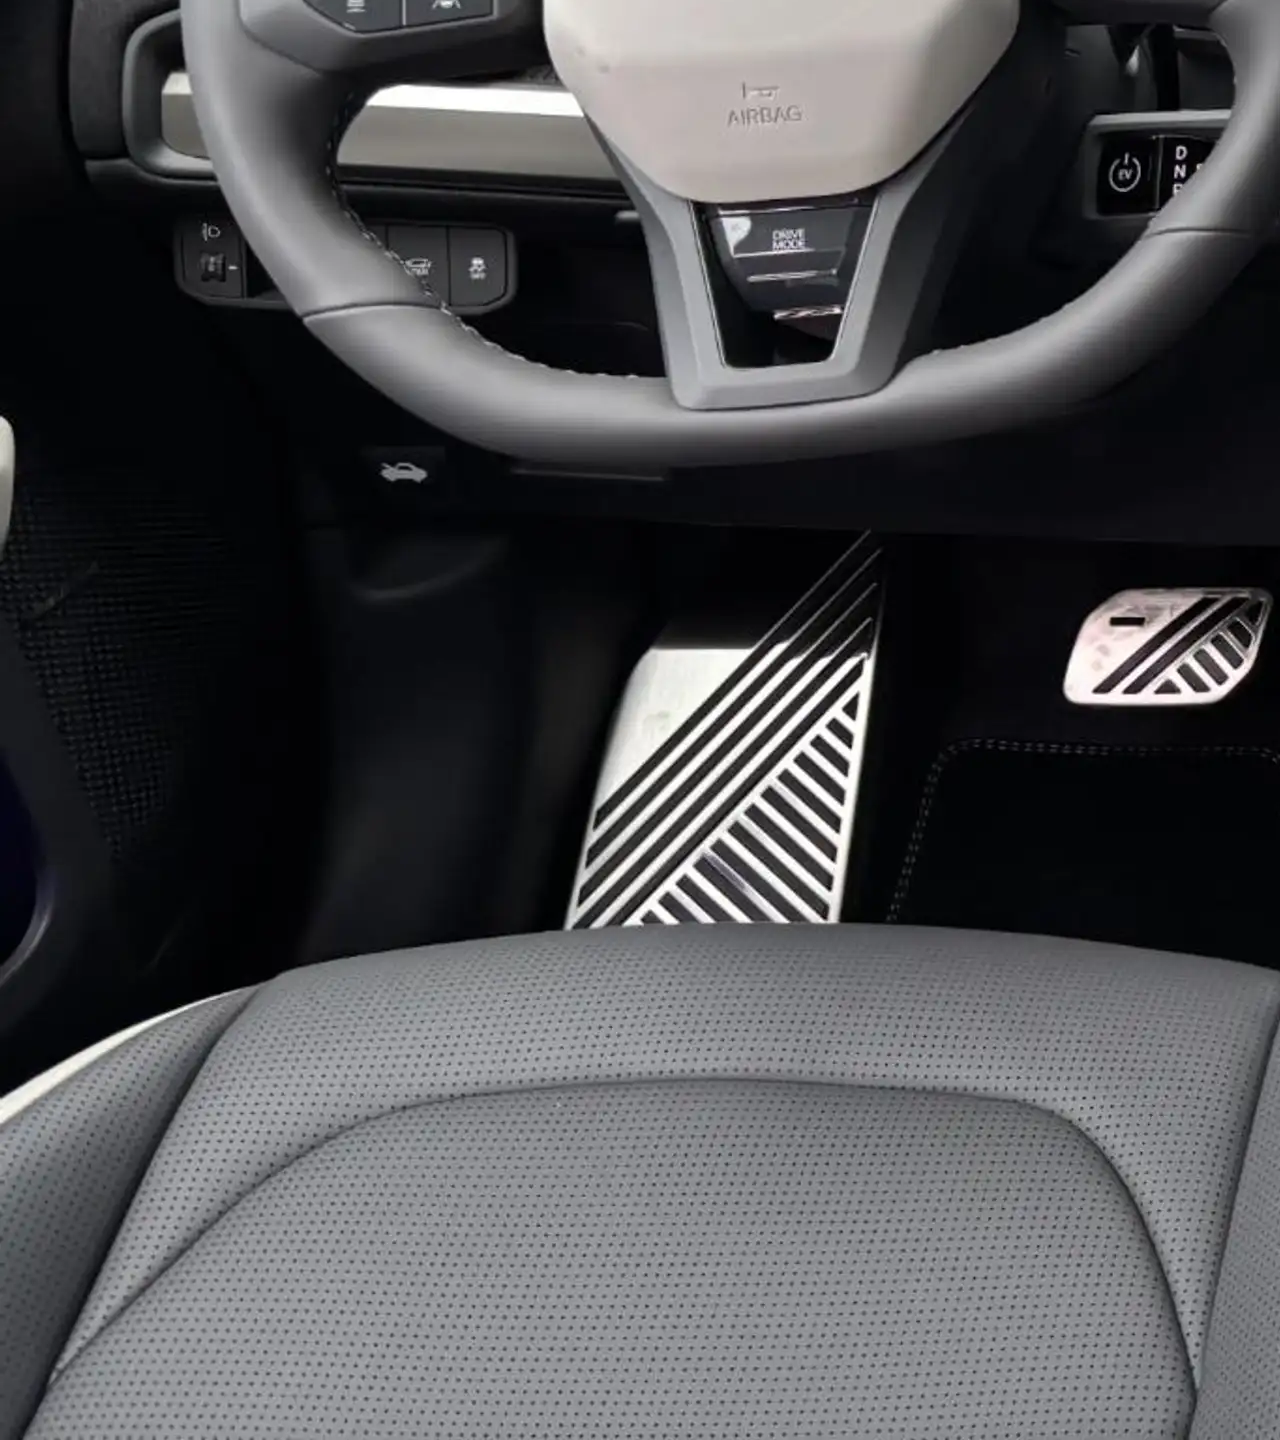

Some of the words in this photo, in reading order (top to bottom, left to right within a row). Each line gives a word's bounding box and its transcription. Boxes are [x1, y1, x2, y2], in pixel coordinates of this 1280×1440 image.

[727, 105, 803, 129] AIRBAG
[1175, 145, 1188, 160] D
[1118, 168, 1132, 180] EV
[1173, 164, 1187, 179] N
